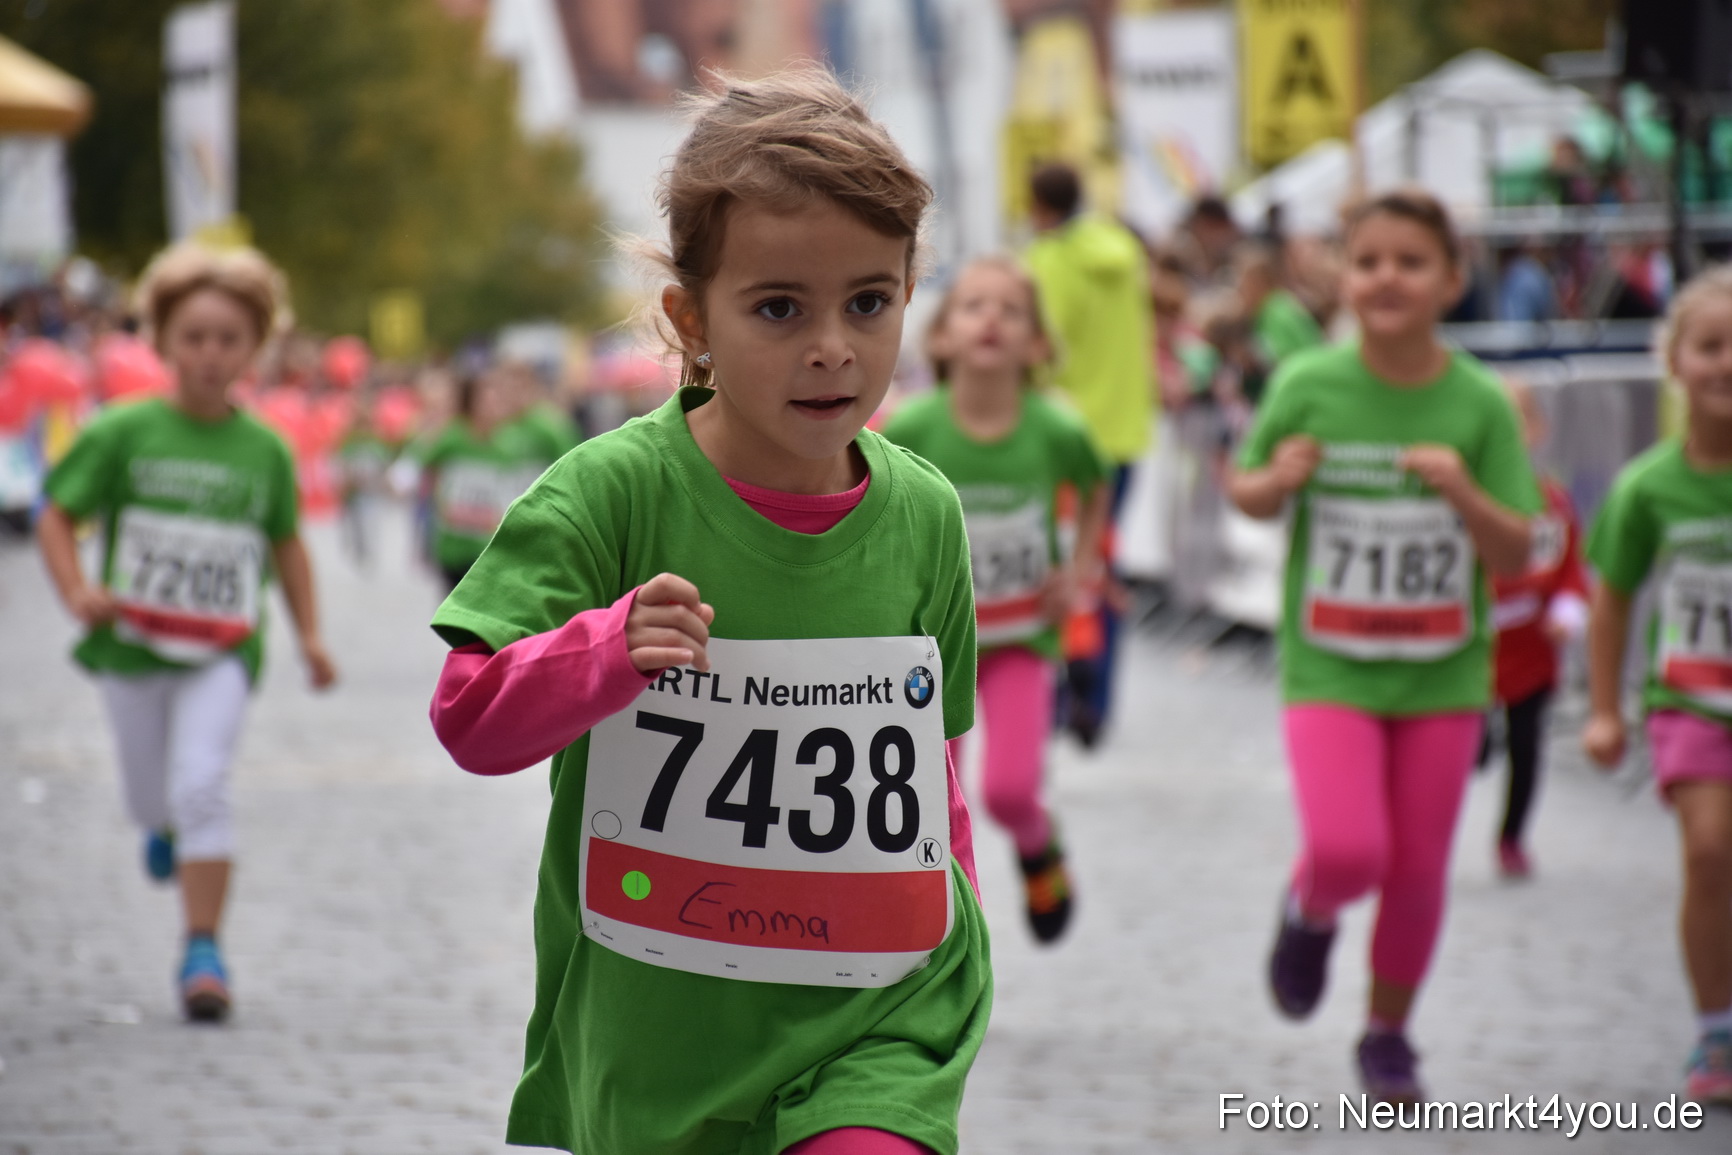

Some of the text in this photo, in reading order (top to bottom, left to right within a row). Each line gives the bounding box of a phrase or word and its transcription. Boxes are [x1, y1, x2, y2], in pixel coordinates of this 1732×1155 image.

[1328, 534, 1458, 597] 7182
[743, 675, 893, 706] Neumarkt
[635, 710, 920, 854] 7438
[924, 842, 935, 863] K
[678, 881, 829, 944] Emma
